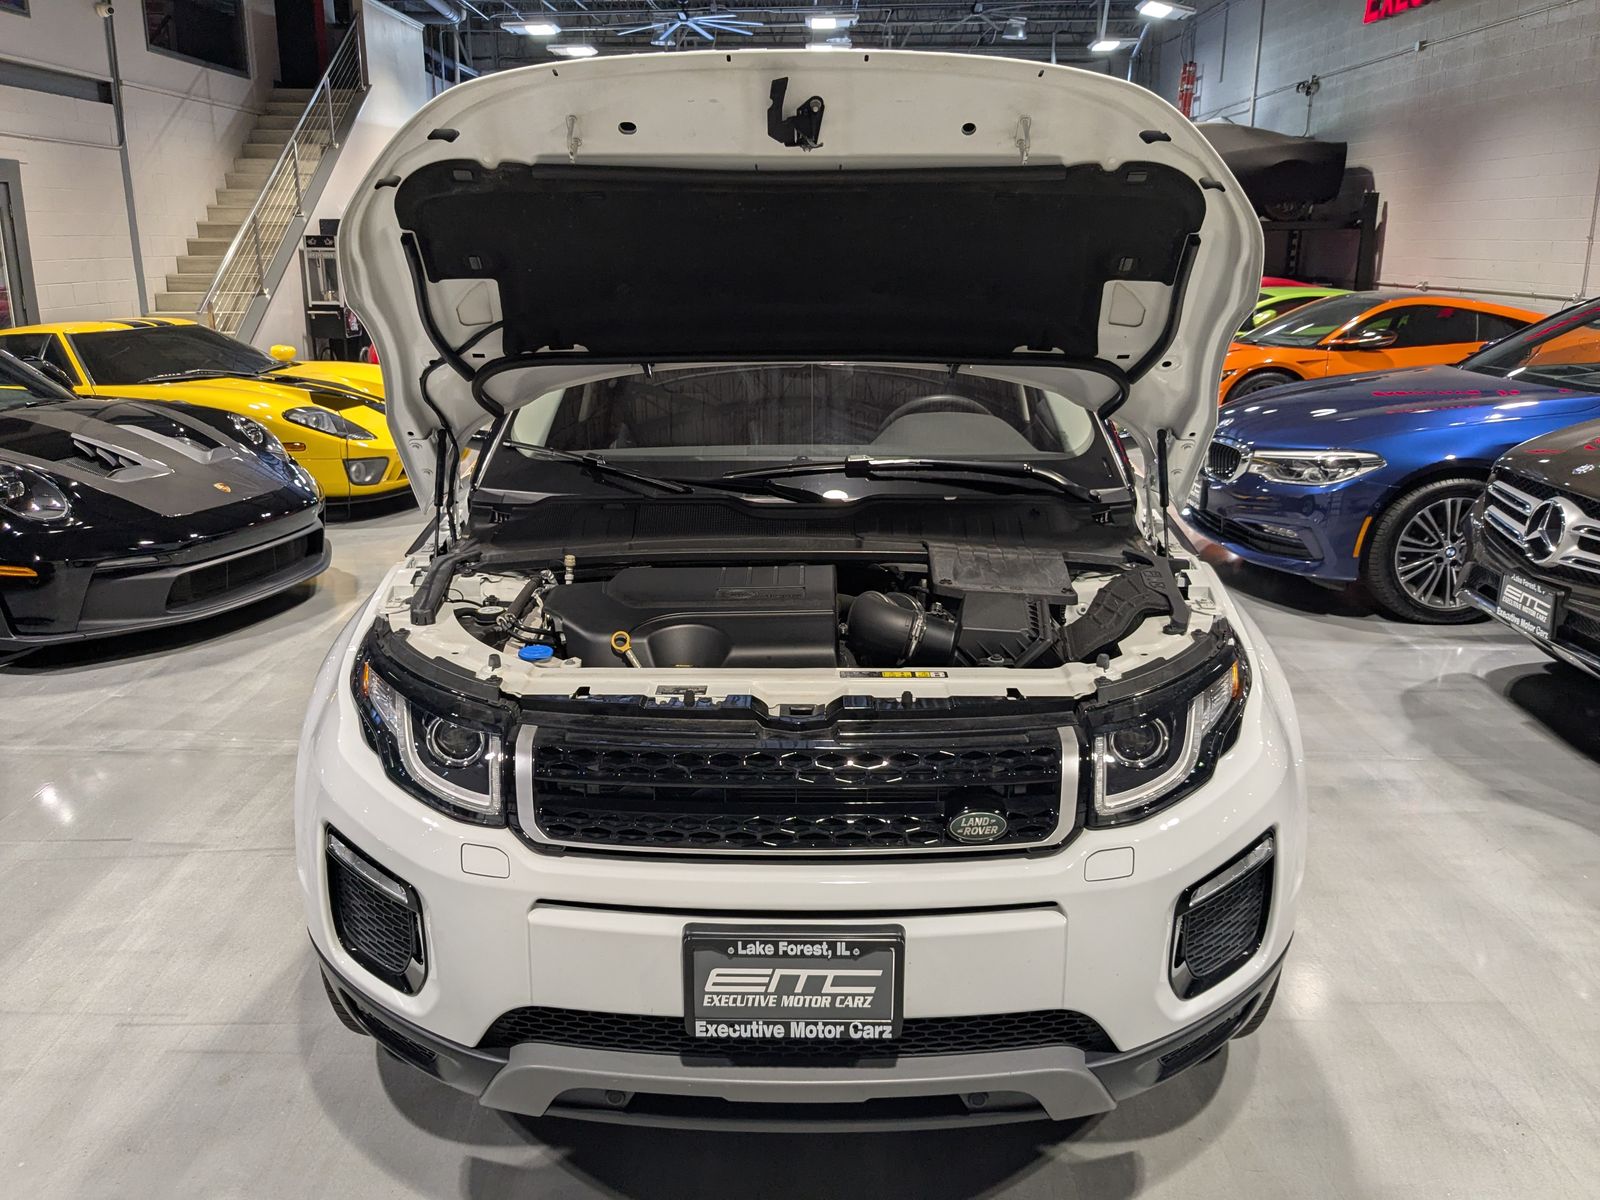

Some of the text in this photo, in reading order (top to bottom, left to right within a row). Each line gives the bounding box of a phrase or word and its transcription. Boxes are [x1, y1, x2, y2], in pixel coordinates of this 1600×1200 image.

[1535, 626, 1549, 640] Carz
[961, 817, 989, 827] LAND
[963, 826, 998, 836] ROVER
[737, 941, 851, 959] Lake Forest, IL
[704, 967, 883, 994] EMC
[703, 994, 874, 1008] EXECUTIVE MOTOR CARZ
[695, 1021, 893, 1039] Executive Motor Carz
